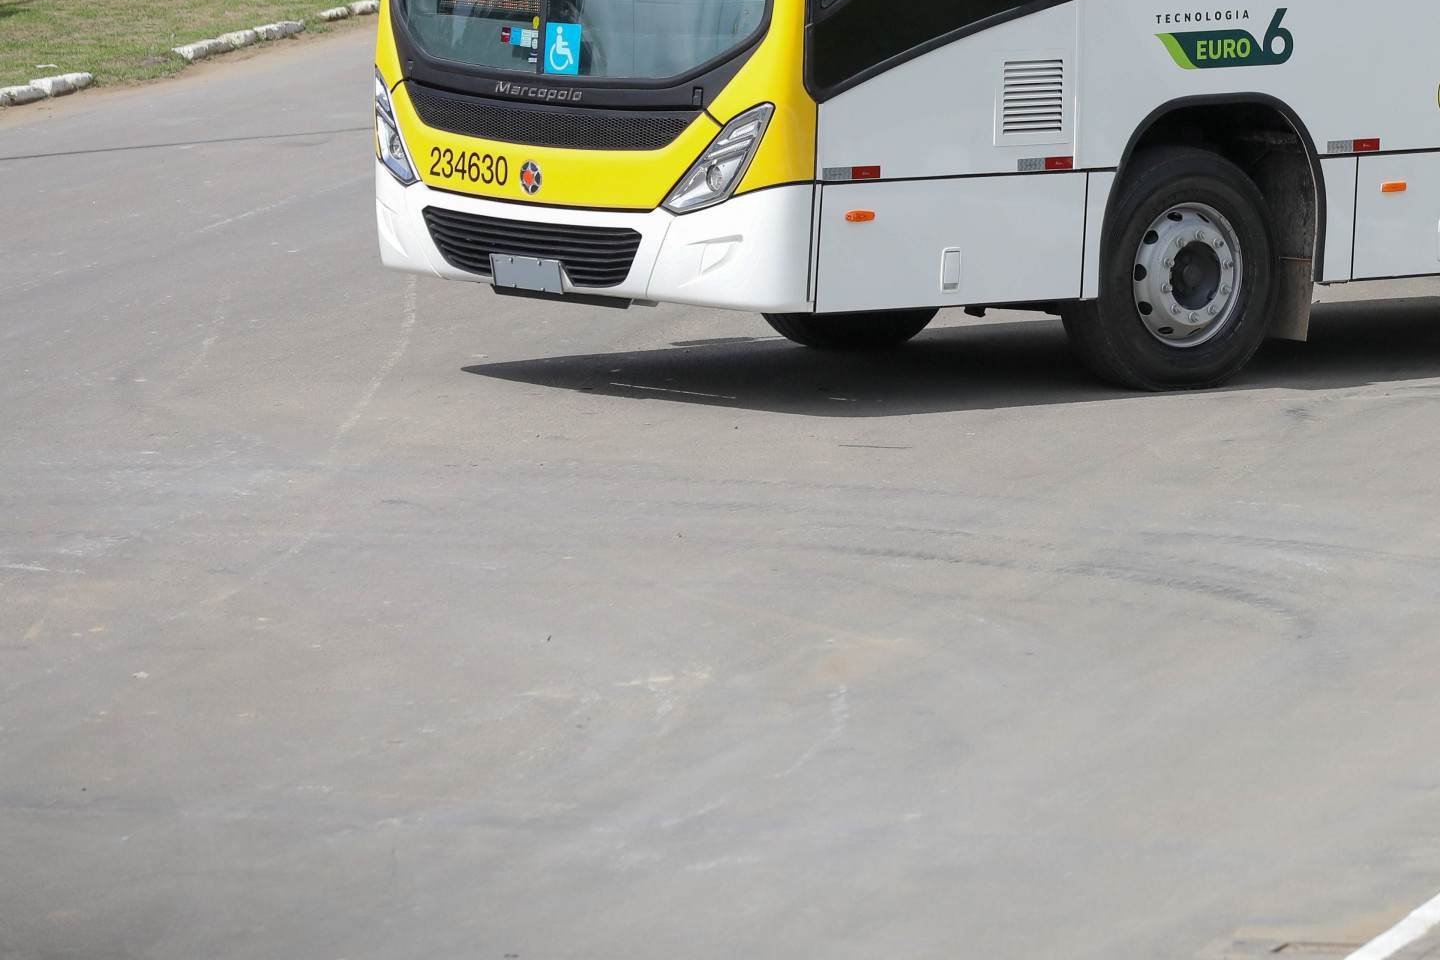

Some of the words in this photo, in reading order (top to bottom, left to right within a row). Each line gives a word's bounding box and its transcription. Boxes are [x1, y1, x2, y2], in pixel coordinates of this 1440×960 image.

[1155, 9, 1250, 24] TECNOLOGIA
[1196, 37, 1251, 60] EURO
[1262, 7, 1294, 64] 6
[495, 80, 582, 102] Marcopolo
[429, 146, 509, 186] 234630
